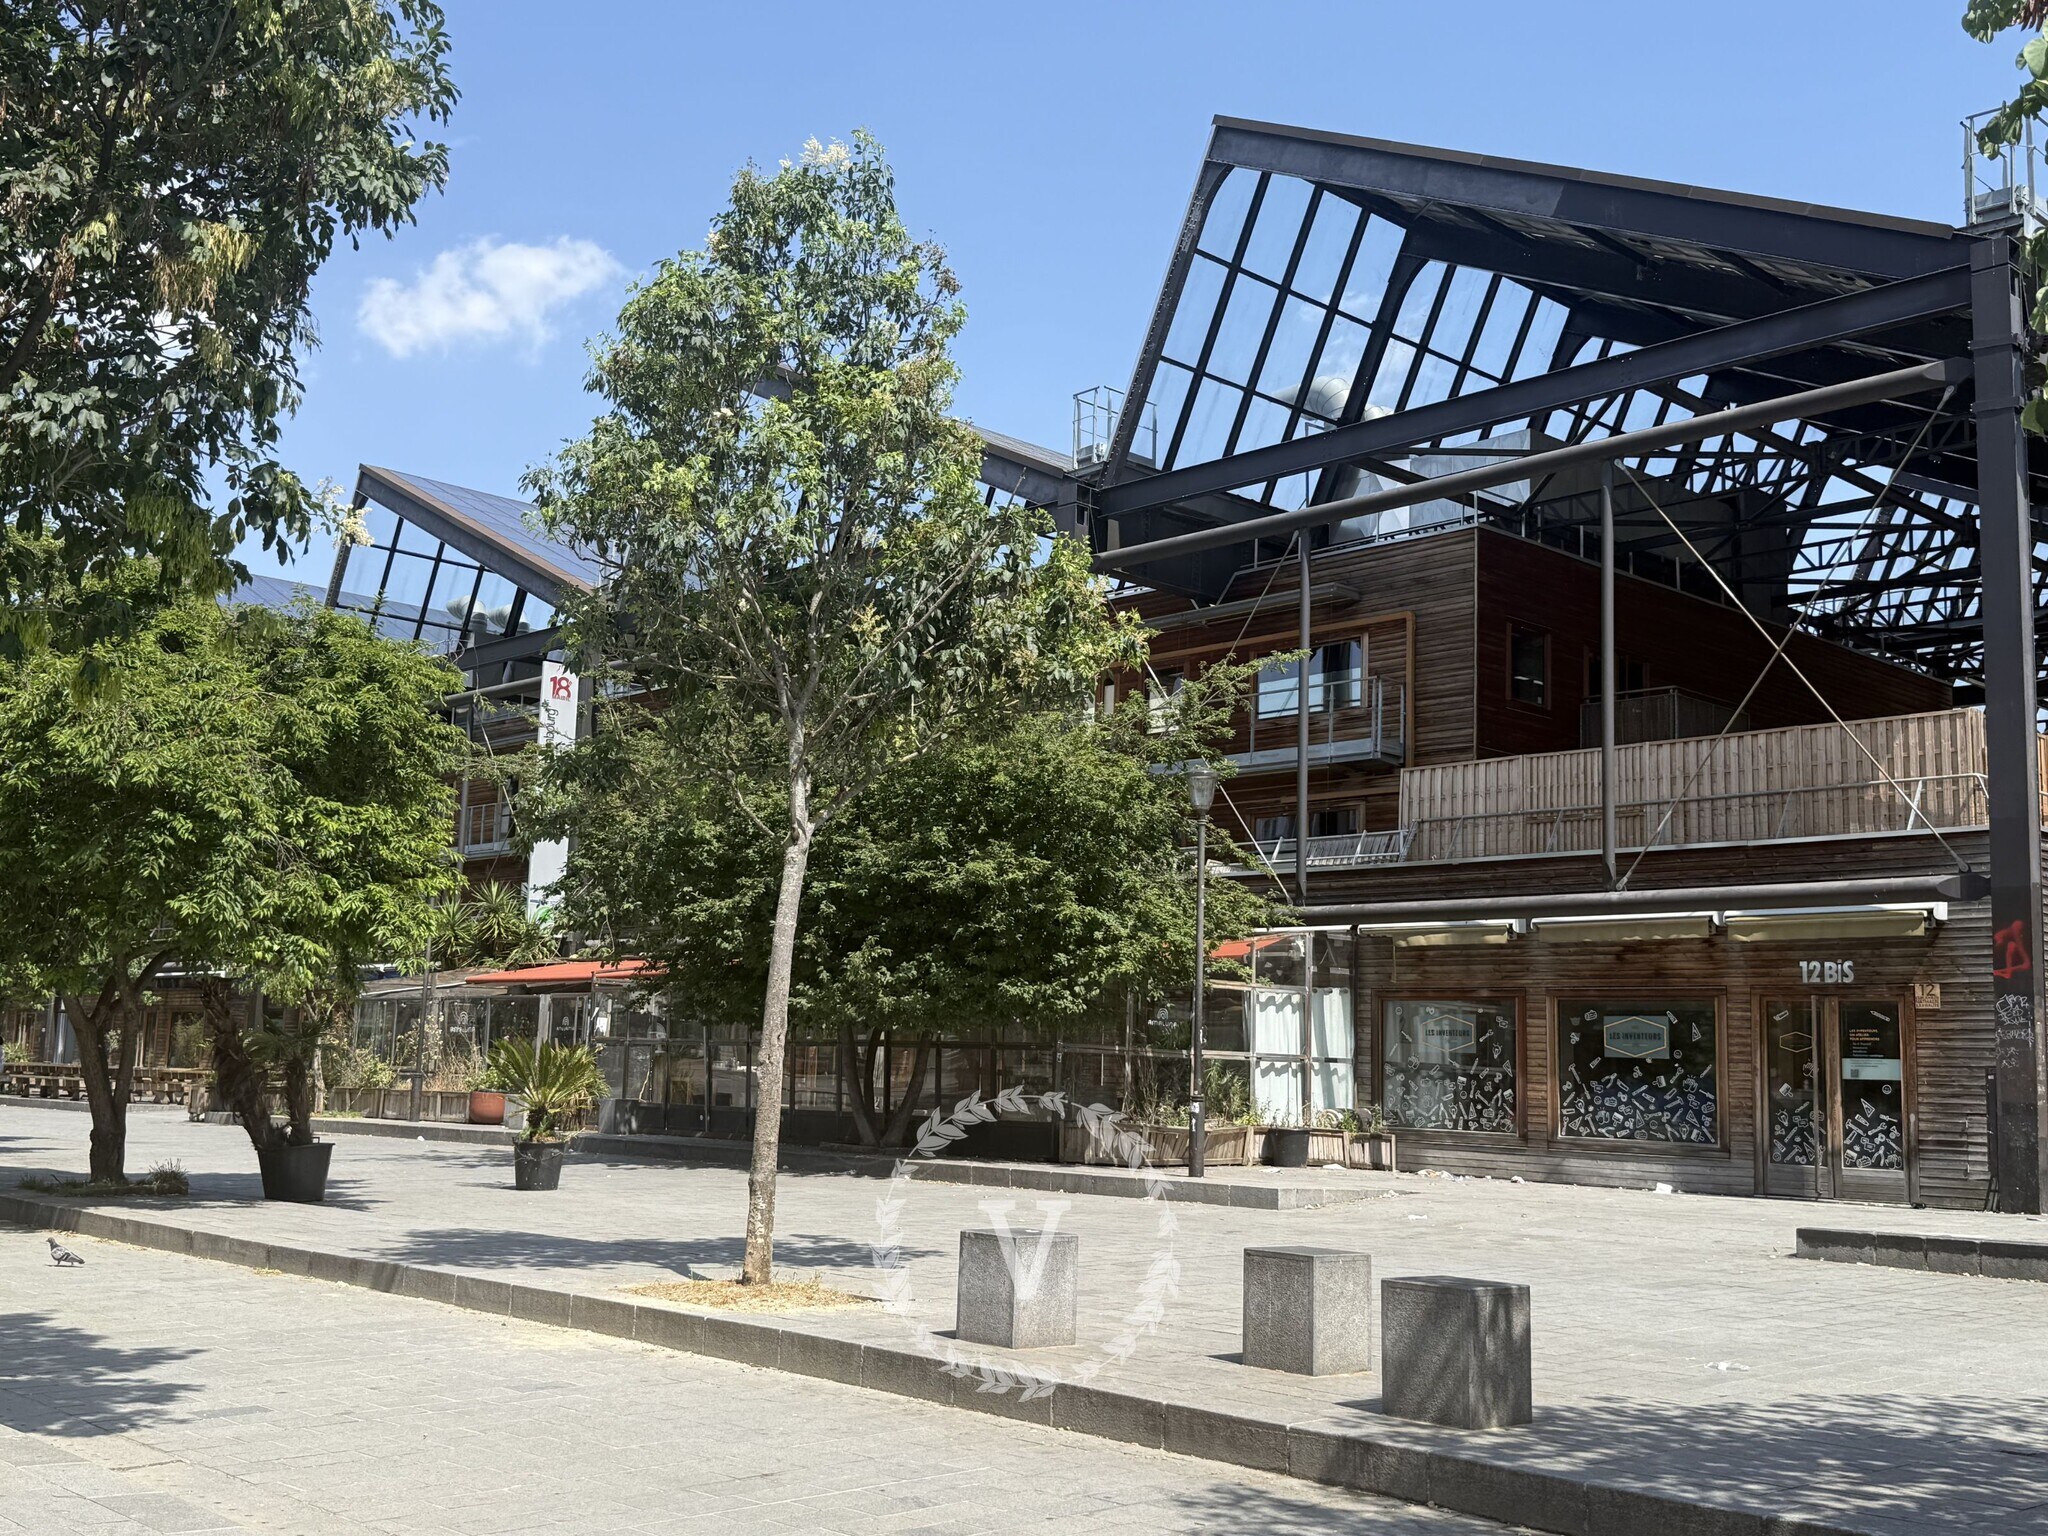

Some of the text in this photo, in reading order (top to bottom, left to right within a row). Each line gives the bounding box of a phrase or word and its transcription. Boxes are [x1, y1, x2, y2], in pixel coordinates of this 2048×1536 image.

[1799, 961, 1821, 983] 12
[1918, 984, 1936, 996] 12
[1436, 1029, 1470, 1037] INVENTEURS
[1609, 1032, 1662, 1040] LES INVENTEURS
